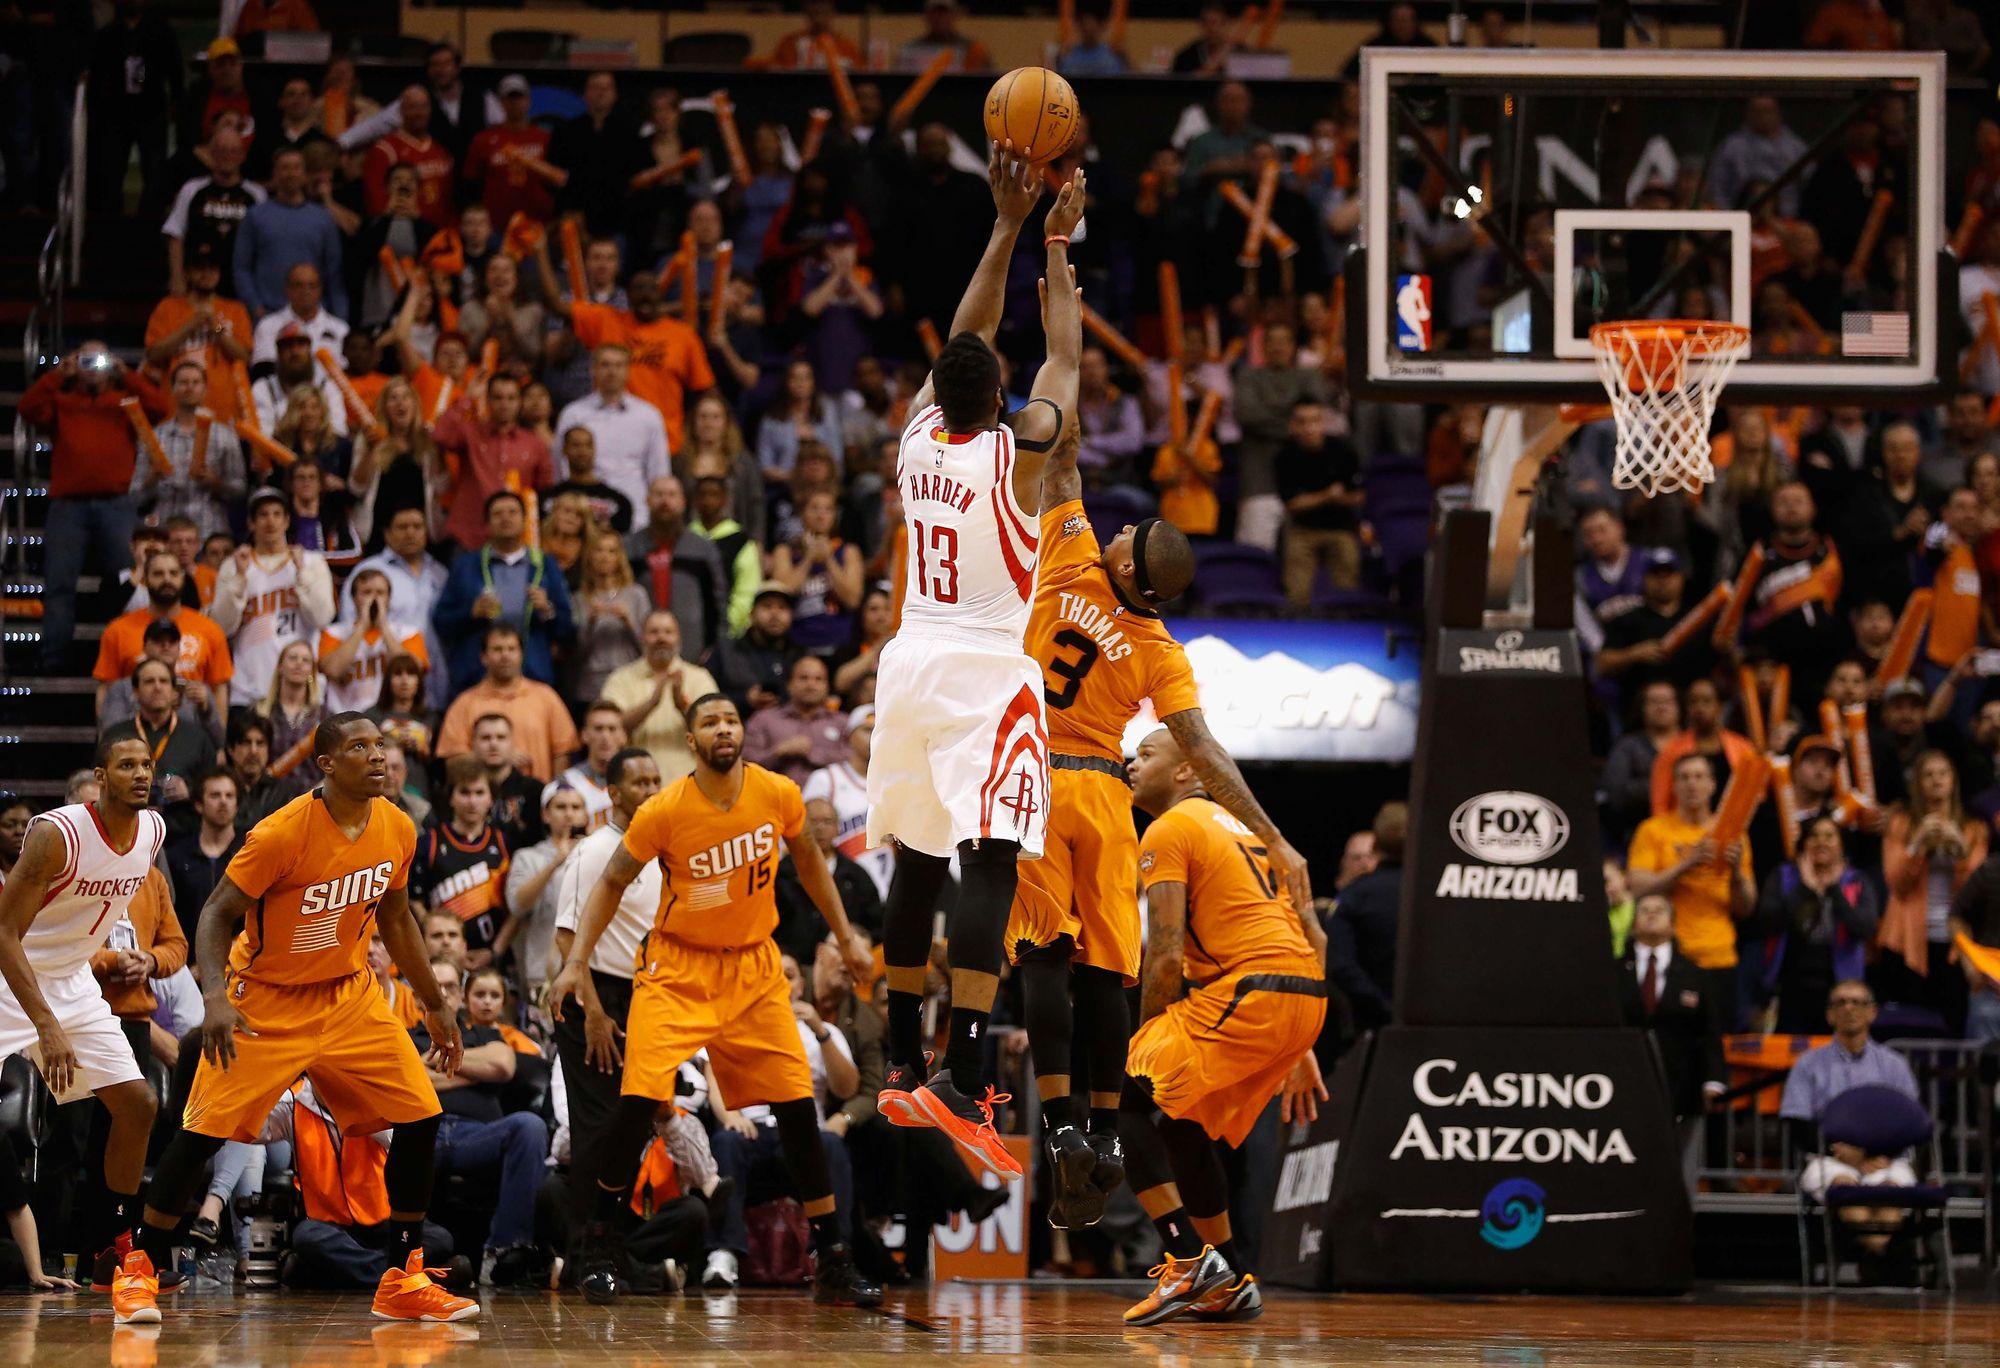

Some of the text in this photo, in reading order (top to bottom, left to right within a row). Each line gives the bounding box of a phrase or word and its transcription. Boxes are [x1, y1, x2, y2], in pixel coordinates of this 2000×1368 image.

[909, 473, 977, 515] HARDEN
[913, 518, 960, 605] 13
[1058, 592, 1133, 662] THOMAS
[1044, 628, 1099, 710] 3
[1459, 646, 1563, 673] SPALDING
[1479, 808, 1540, 834] FOX
[687, 822, 775, 880] SUNS
[73, 876, 146, 897] ROCKETS
[300, 860, 393, 915] SUNS
[747, 855, 770, 896] 15
[1435, 863, 1578, 902] ARIZONA
[88, 900, 111, 936] 1
[1412, 1058, 1615, 1110] CASINO
[1389, 1112, 1637, 1164] ARIZONA
